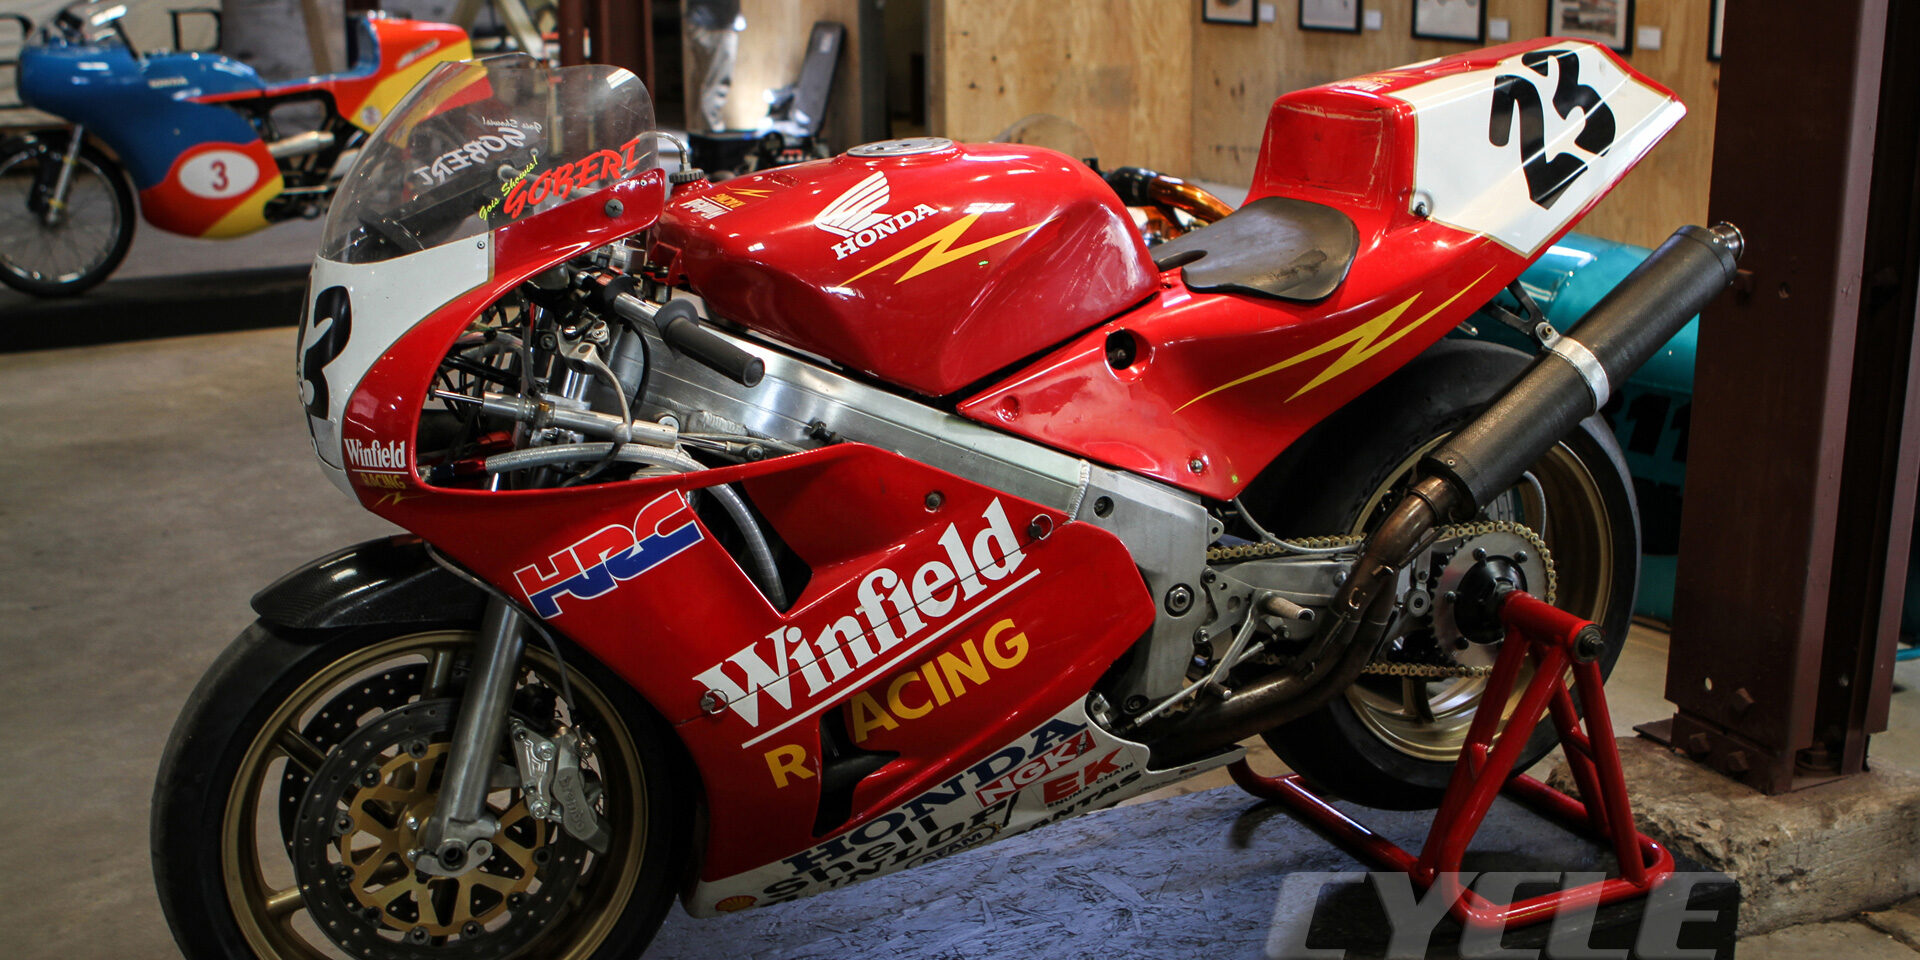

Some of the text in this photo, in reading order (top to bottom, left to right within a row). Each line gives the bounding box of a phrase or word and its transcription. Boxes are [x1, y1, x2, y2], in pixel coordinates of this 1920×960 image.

[1489, 50, 1616, 210] 23
[210, 160, 229, 192] 3
[503, 138, 640, 219] GOBERT
[831, 203, 939, 261] HONDA
[344, 438, 406, 469] Winfield
[360, 472, 407, 490] RACING
[513, 488, 706, 620] HRC
[692, 496, 1027, 728] Winfield
[781, 718, 1089, 877] HONDA
[979, 742, 1077, 805] NGK
[1012, 771, 1142, 836] ANTAS
[1043, 747, 1124, 804] EK
[1047, 786, 1091, 808] ENUMA
[1096, 762, 1134, 785] CHAIN
[763, 815, 939, 898] Shell
